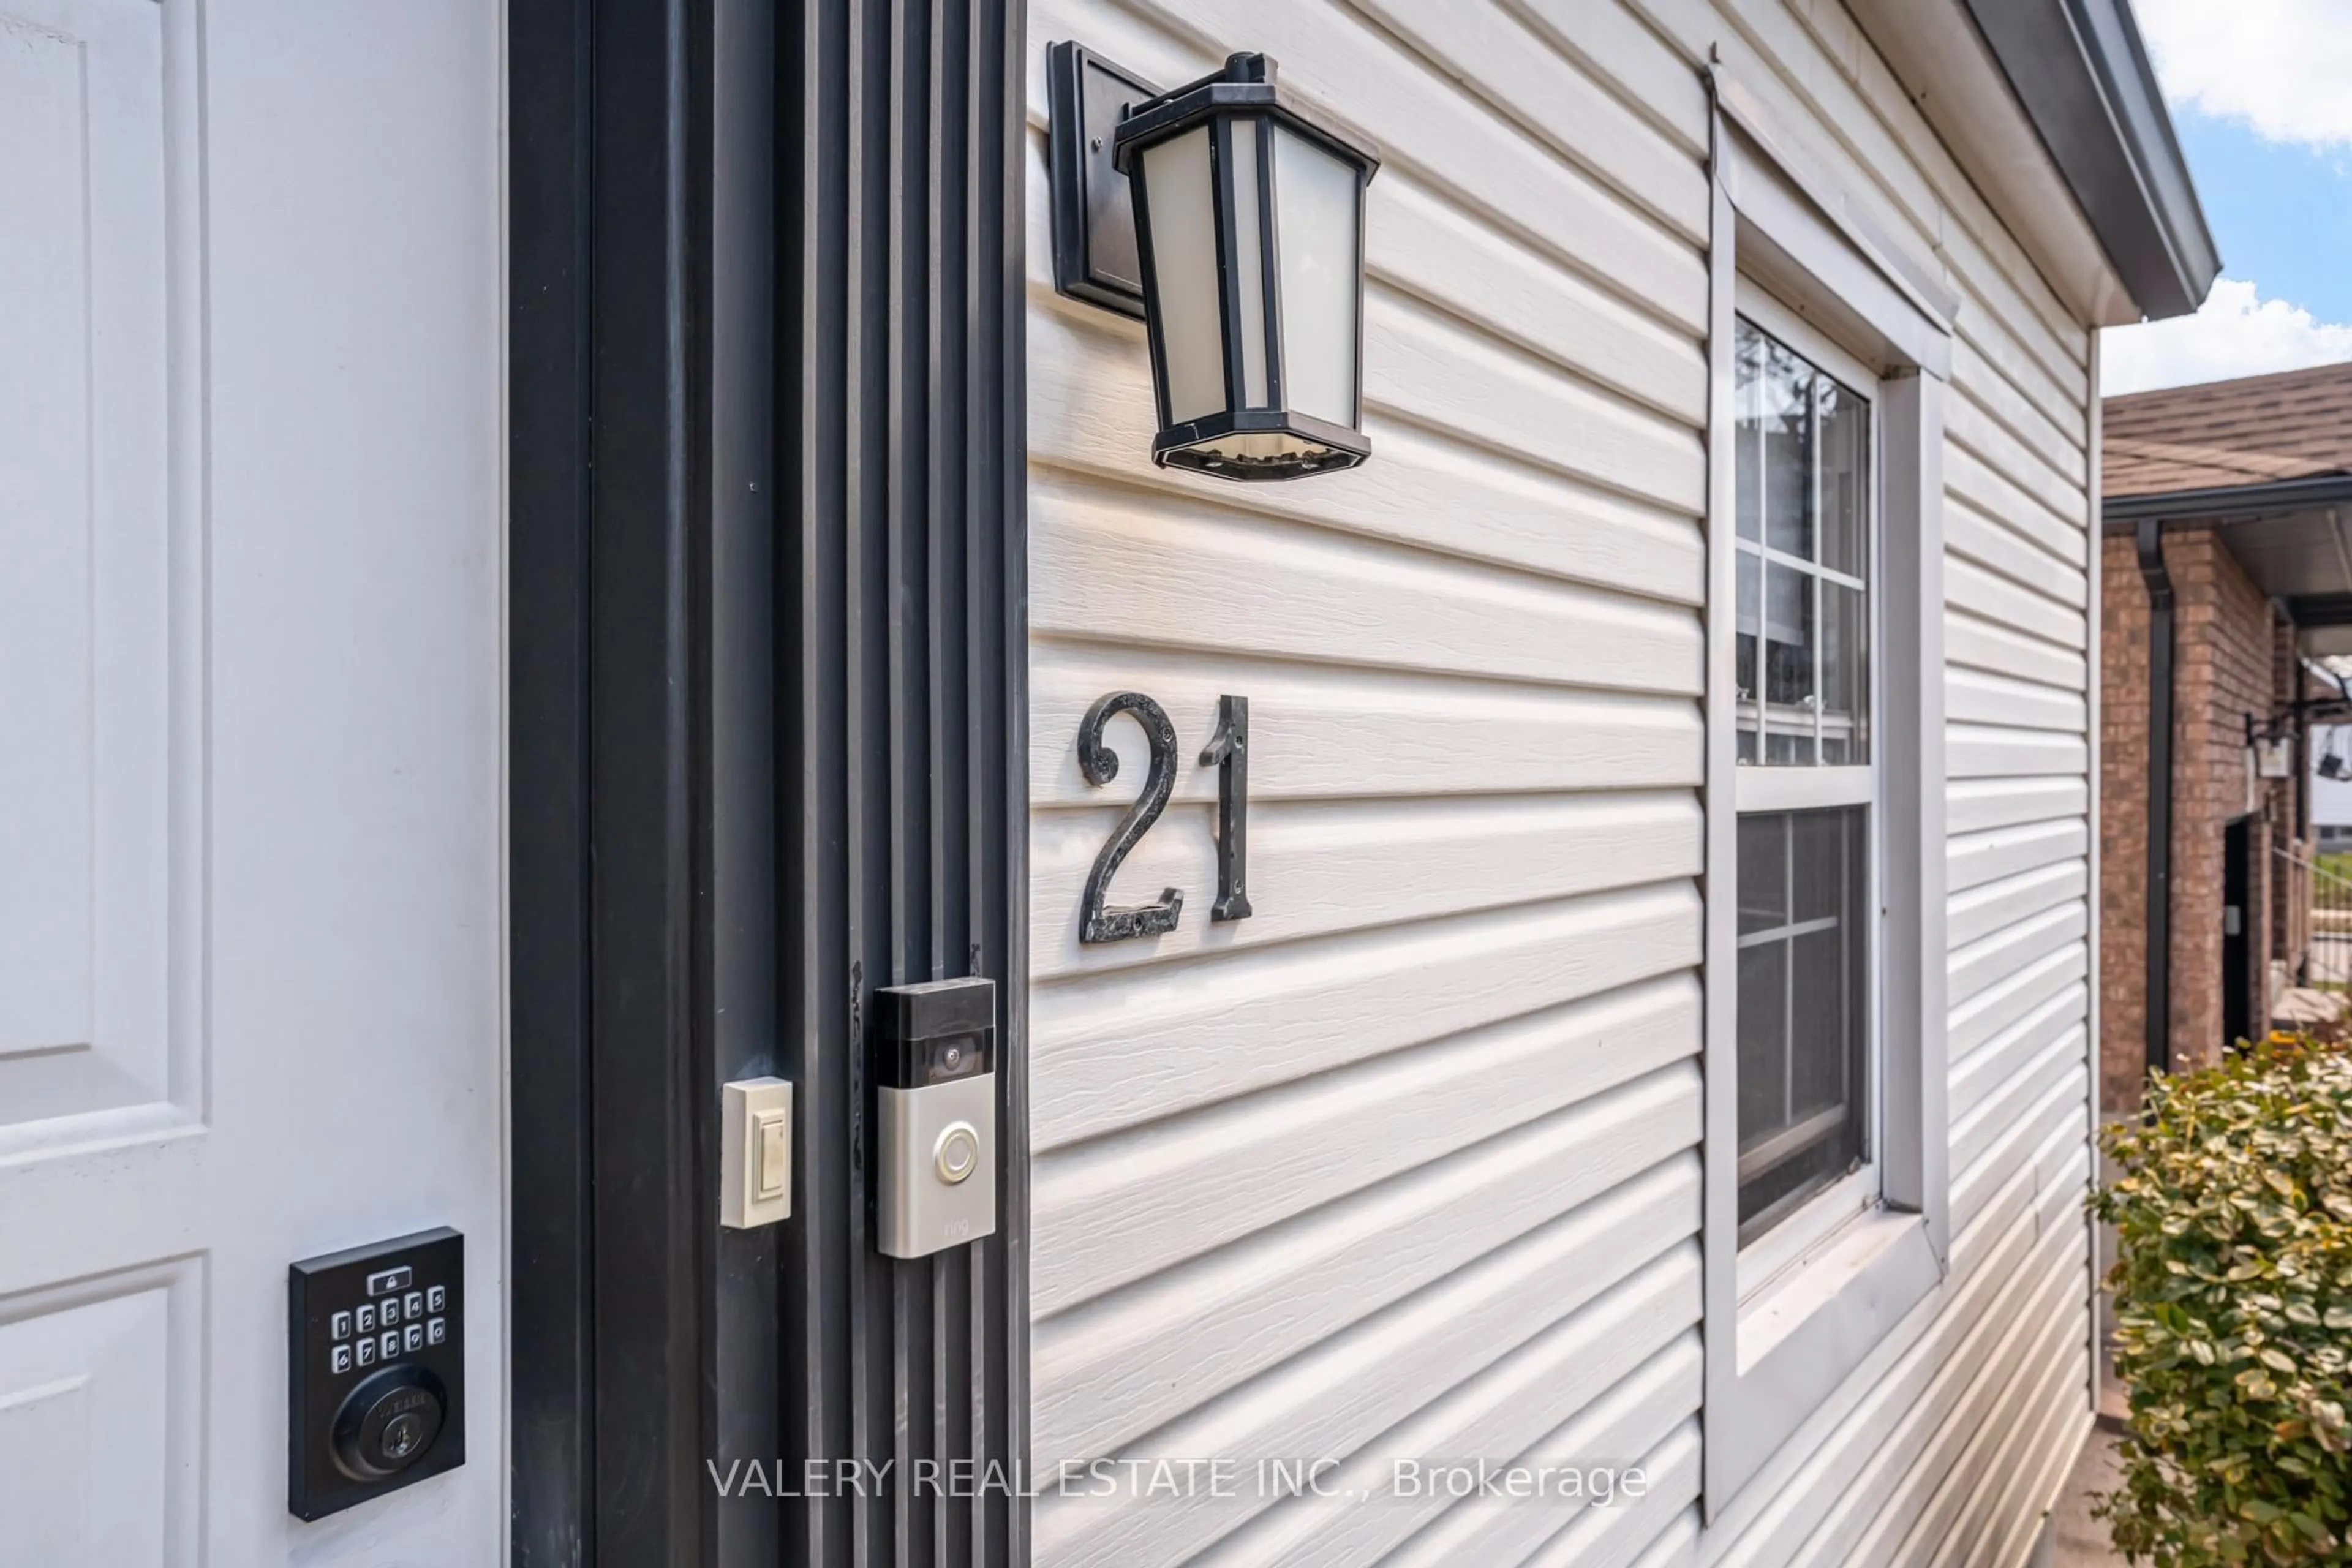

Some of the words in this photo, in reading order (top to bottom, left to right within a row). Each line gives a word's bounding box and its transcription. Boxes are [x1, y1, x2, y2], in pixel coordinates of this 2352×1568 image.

[1077, 690, 1253, 944] 21
[340, 1321, 347, 1332] 1
[363, 1314, 372, 1326] 2
[388, 1308, 396, 1319] 3
[411, 1301, 420, 1312] 4
[434, 1294, 442, 1306] 5
[339, 1354, 349, 1366] 6
[363, 1346, 372, 1359] 7
[388, 1340, 396, 1352] 8
[411, 1333, 420, 1345] 9
[434, 1327, 443, 1338] 0
